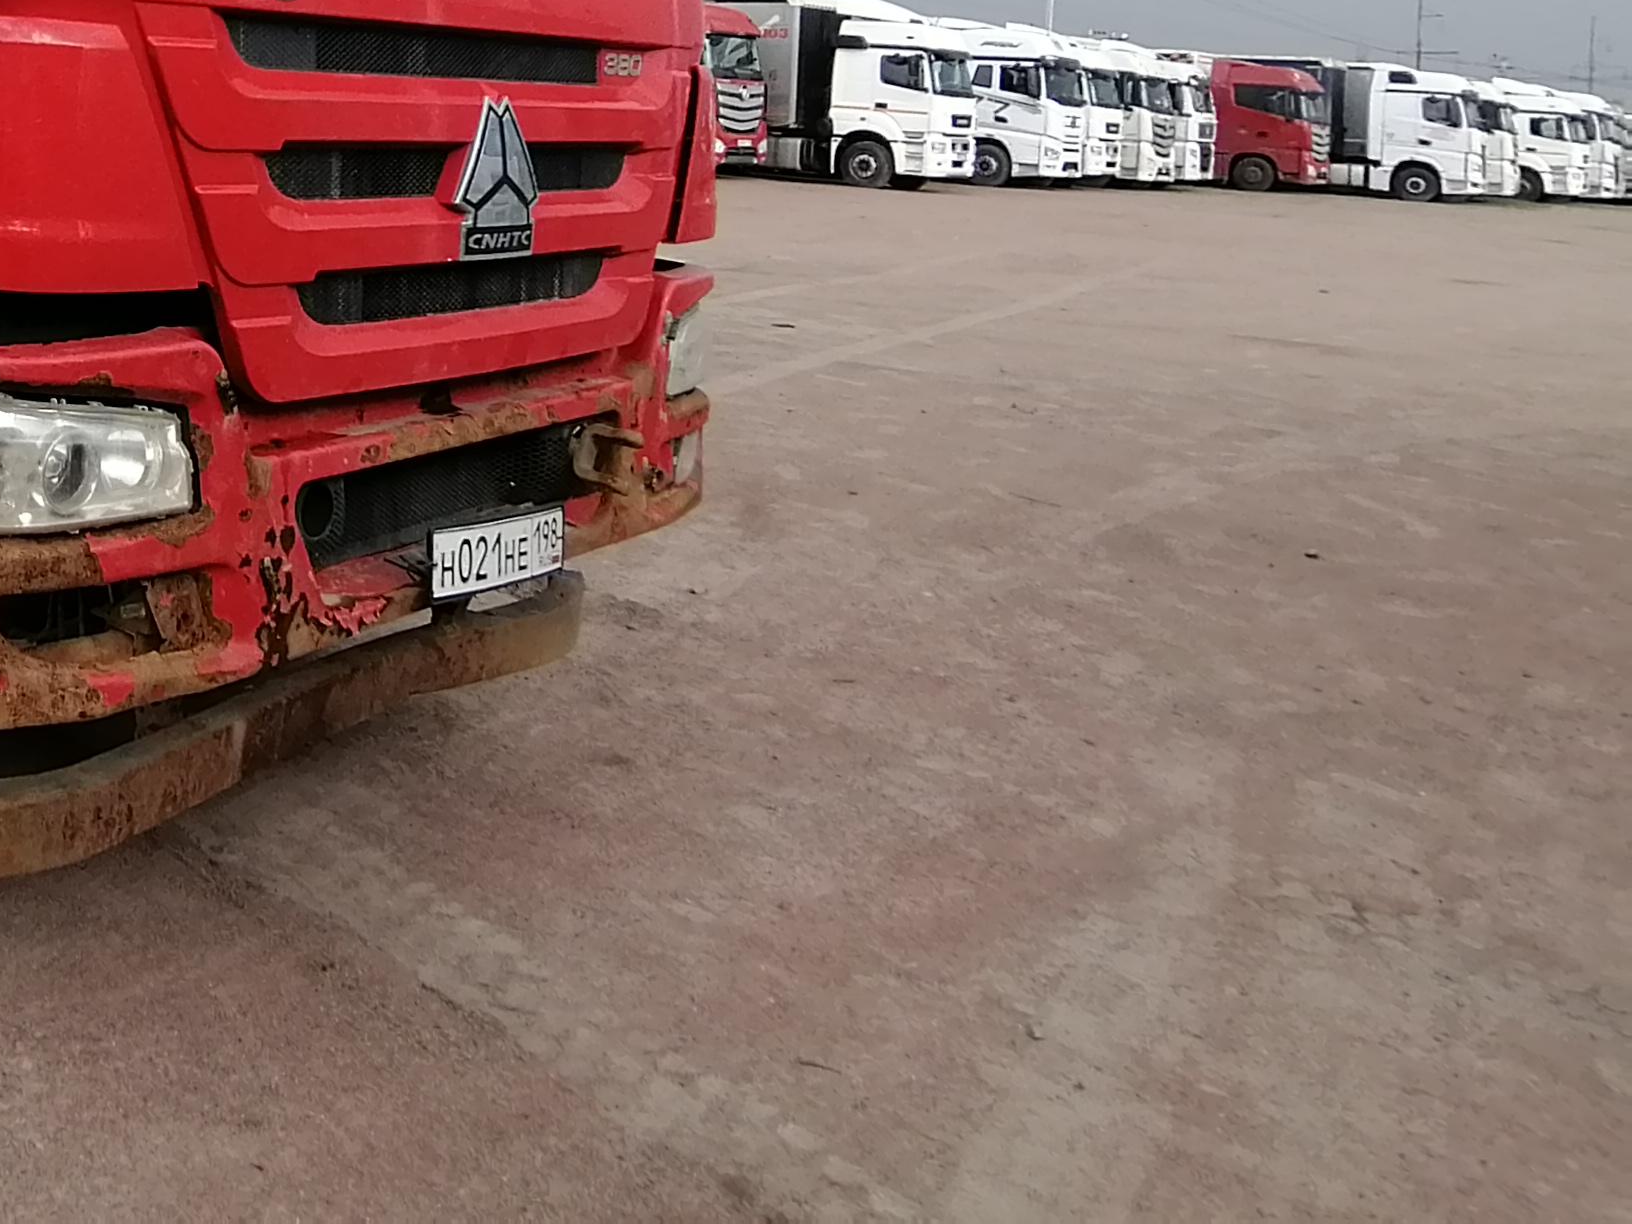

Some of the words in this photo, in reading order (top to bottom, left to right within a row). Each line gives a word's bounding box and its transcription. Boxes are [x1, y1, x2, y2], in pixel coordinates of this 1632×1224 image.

[604, 53, 643, 76] 380
[468, 229, 532, 250] CNHTC
[533, 517, 558, 555] 198
